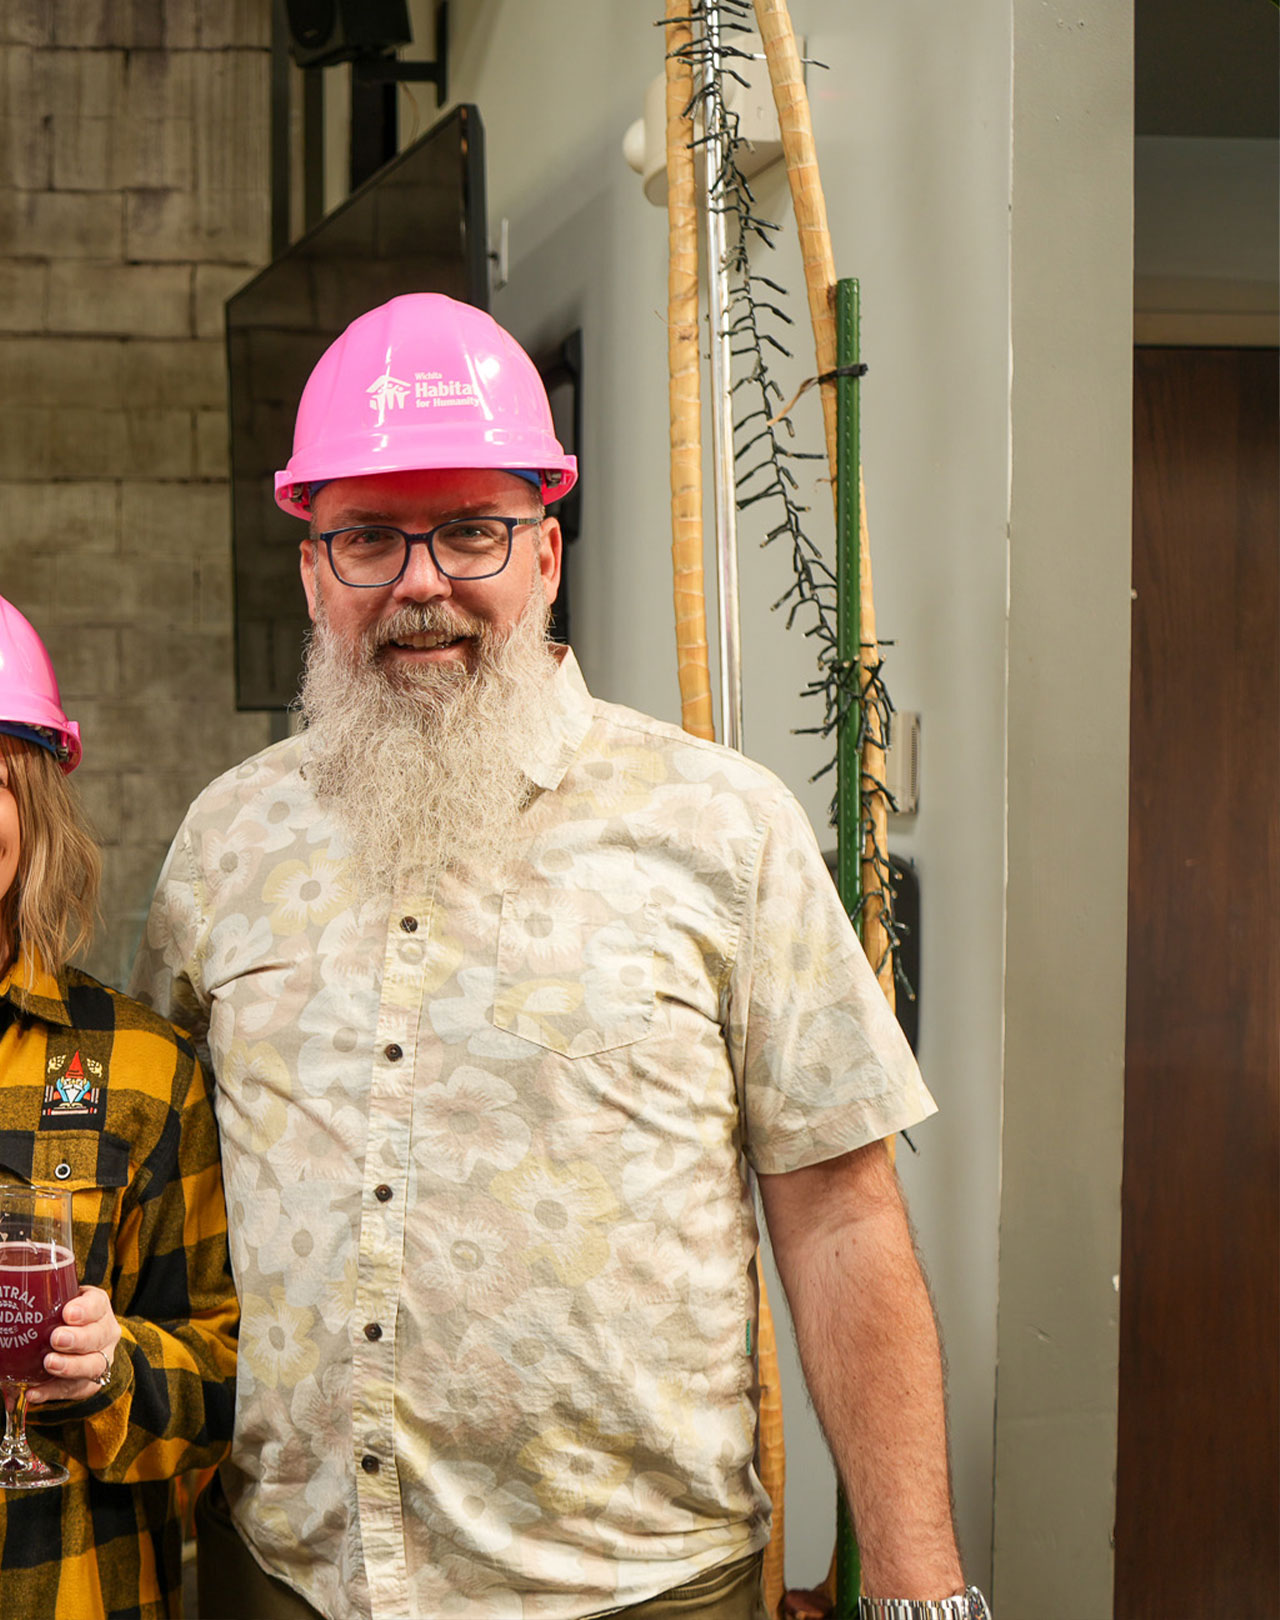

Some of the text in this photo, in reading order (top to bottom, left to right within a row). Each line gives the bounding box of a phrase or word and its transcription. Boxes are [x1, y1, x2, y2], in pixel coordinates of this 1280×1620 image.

[415, 372, 443, 380] Wichita
[415, 396, 480, 408] for Humanity
